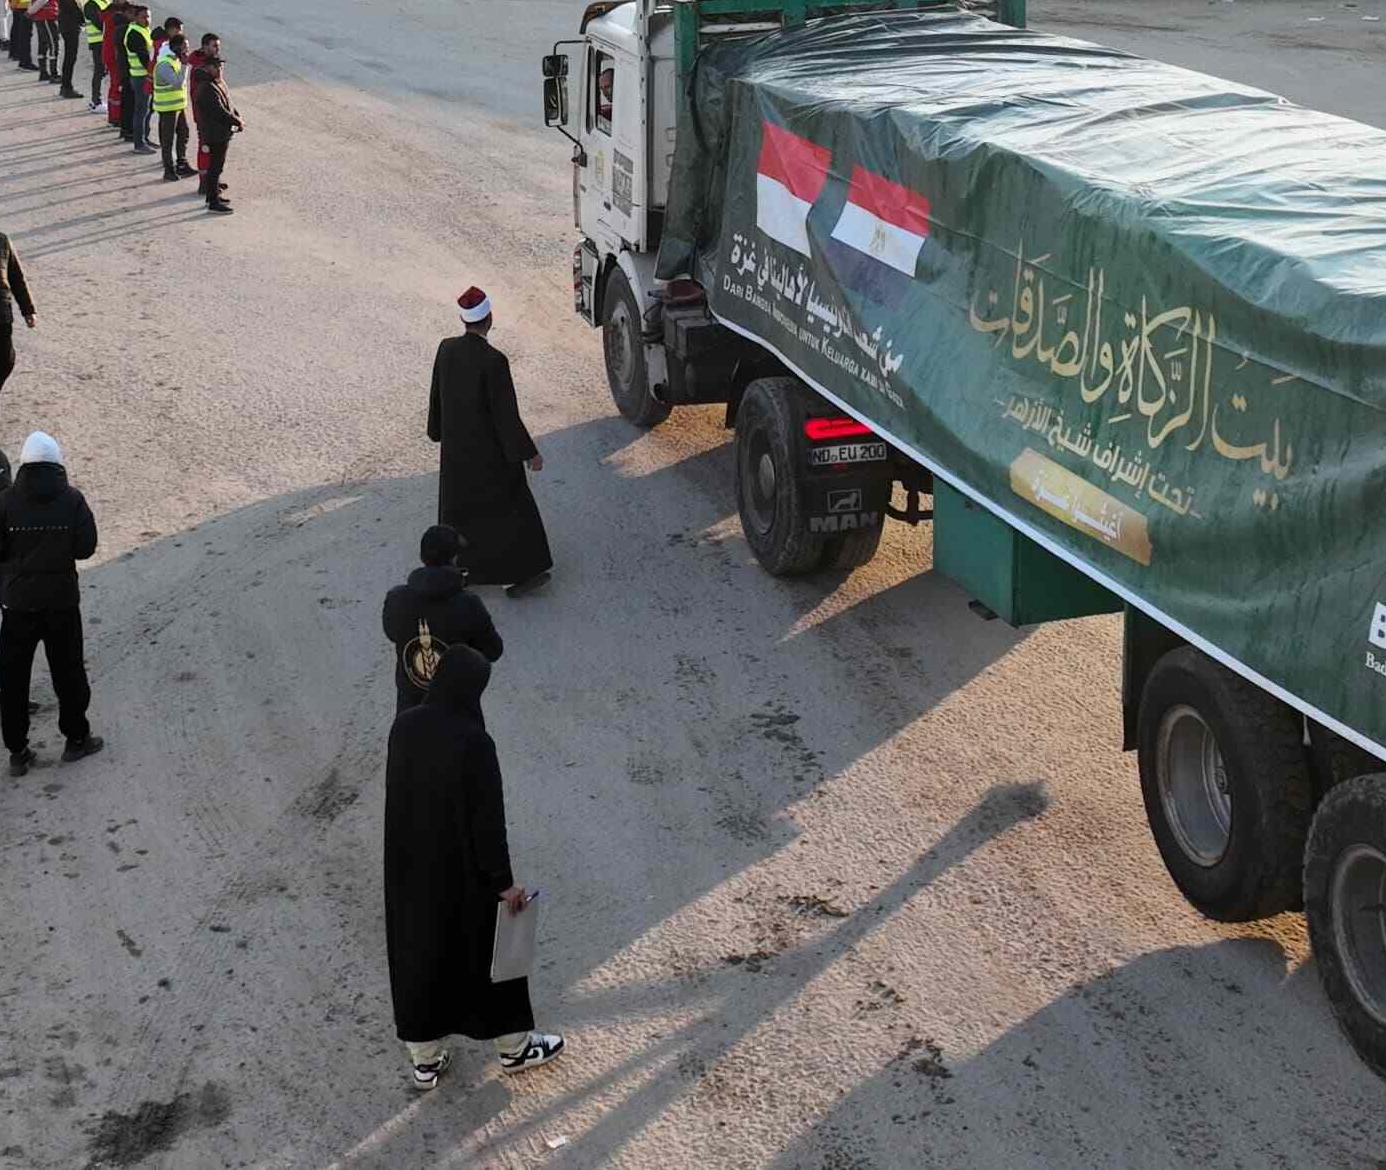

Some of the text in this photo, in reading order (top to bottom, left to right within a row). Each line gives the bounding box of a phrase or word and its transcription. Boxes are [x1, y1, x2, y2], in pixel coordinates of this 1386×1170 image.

[730, 233, 757, 277] غزة
[878, 339, 904, 378] من
[1048, 410, 1094, 458] شيخ
[1092, 446, 1151, 499] إشراف
[1146, 471, 1196, 517] تحت
